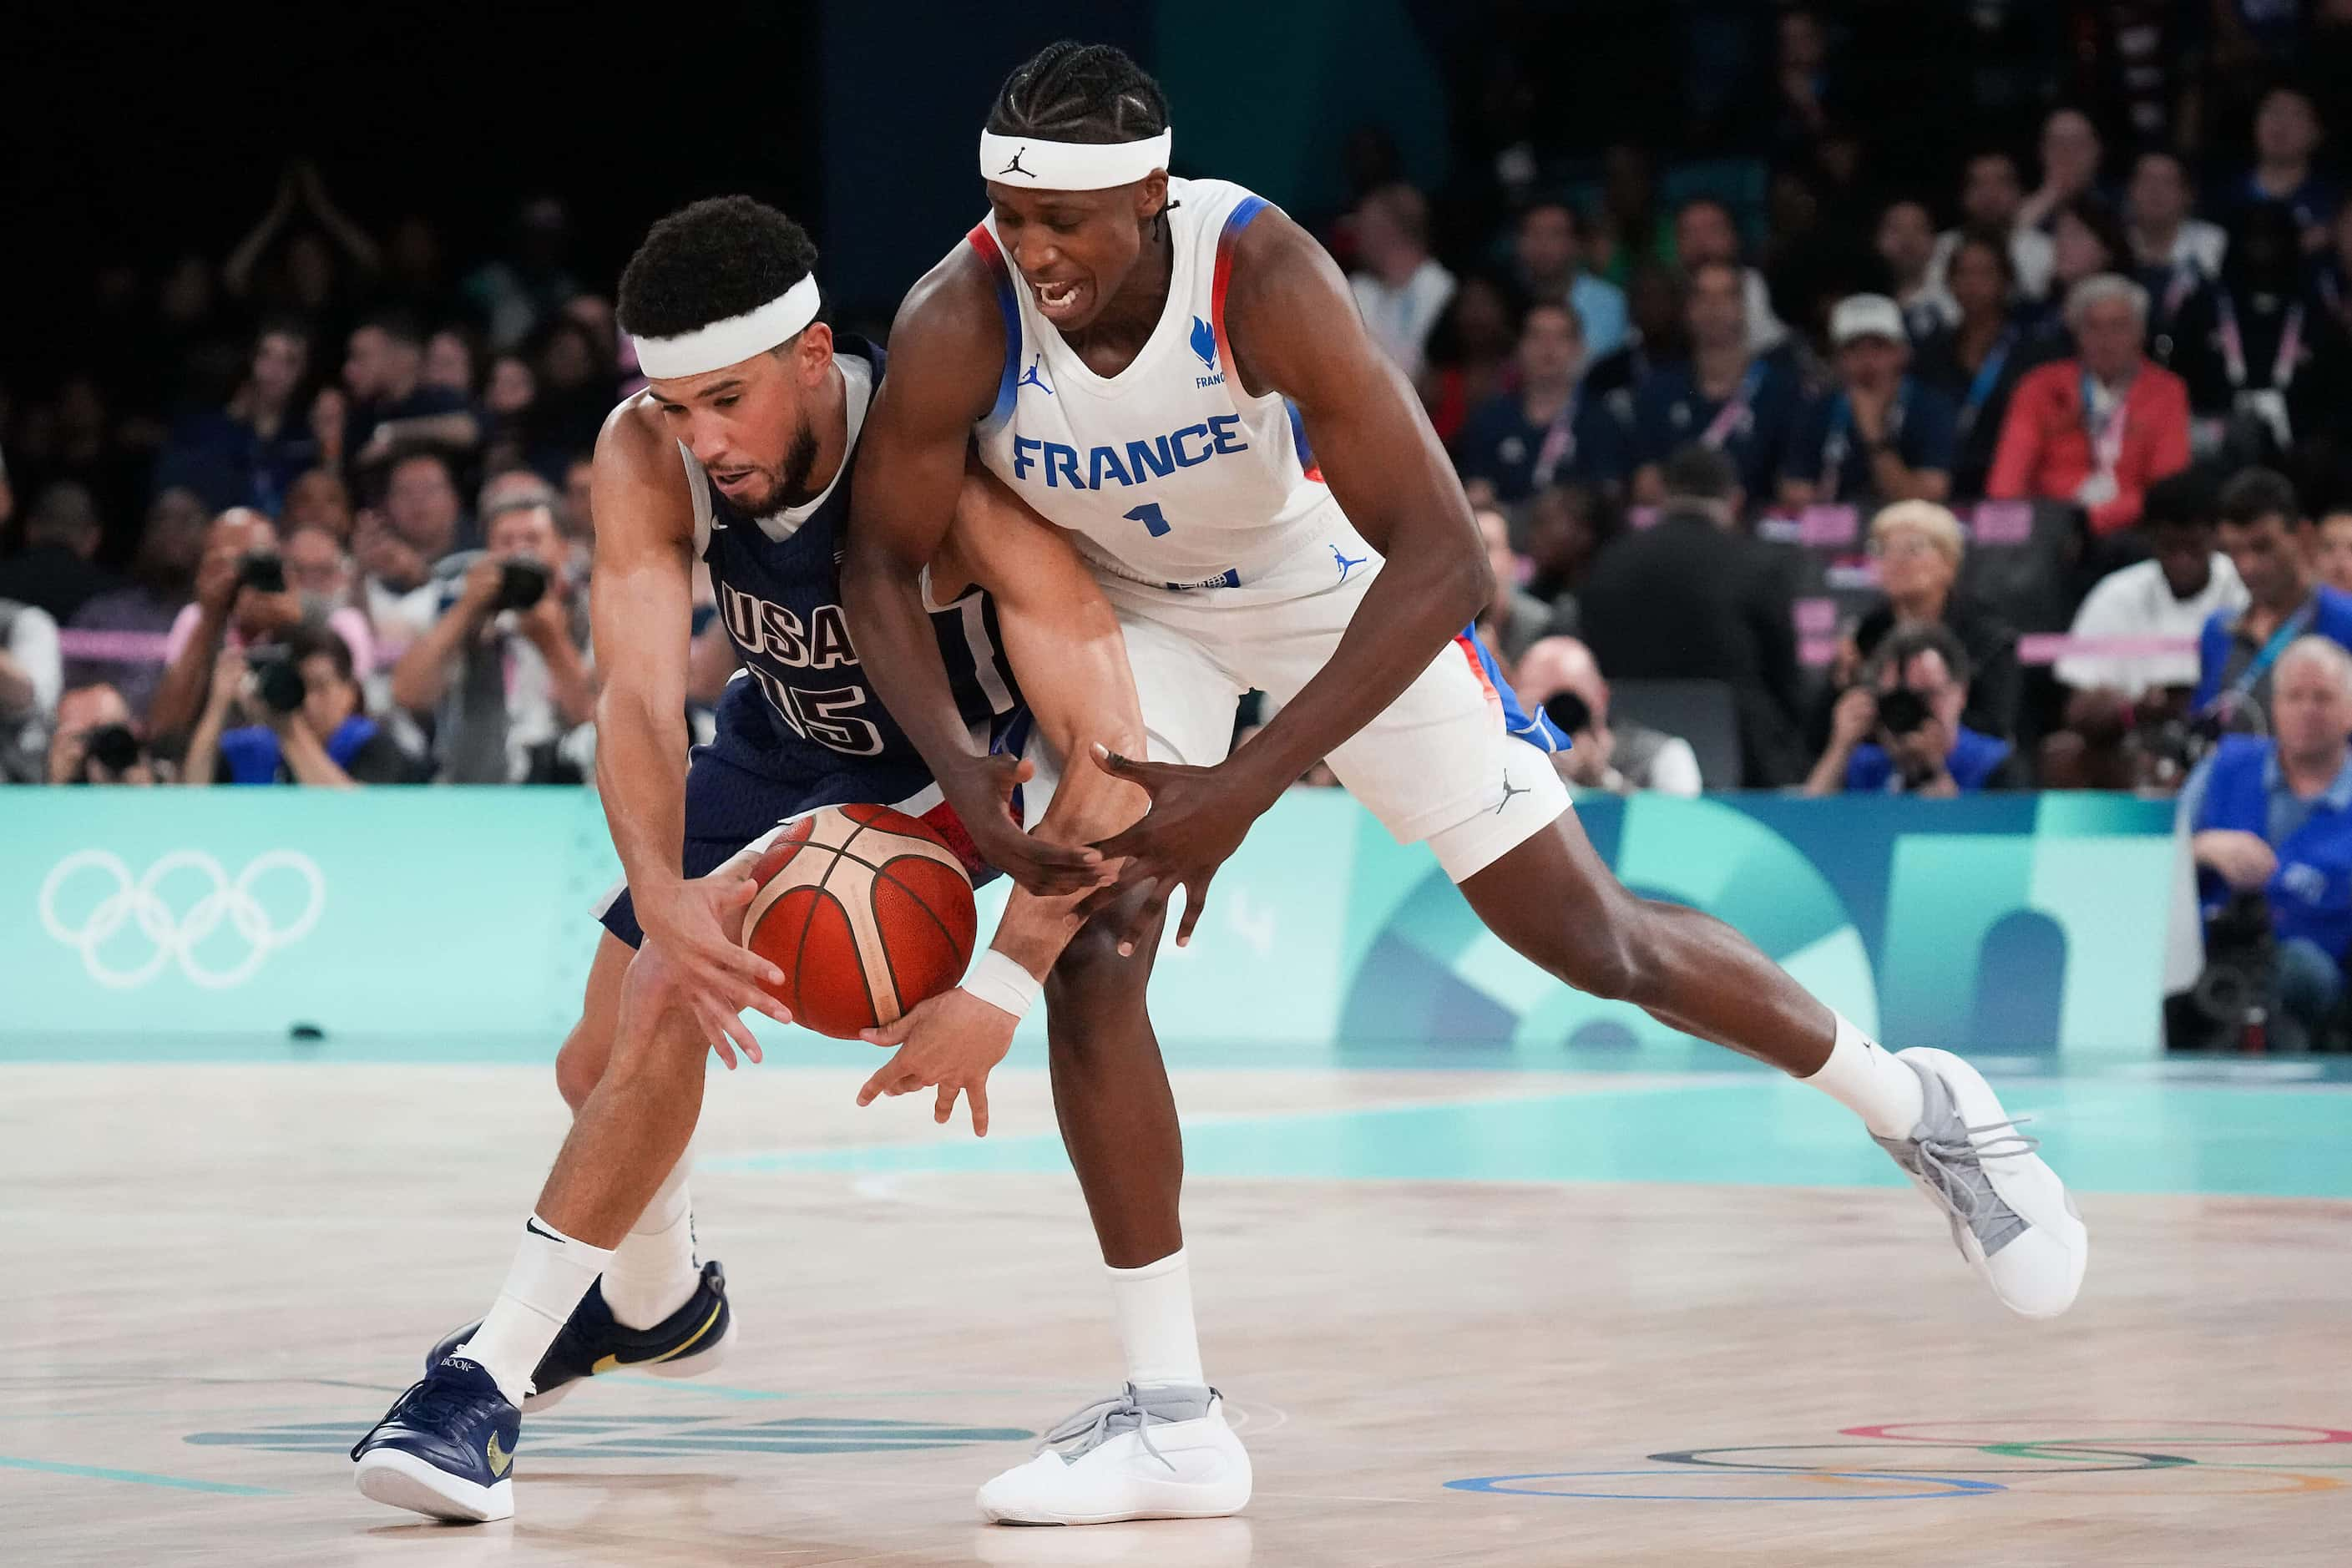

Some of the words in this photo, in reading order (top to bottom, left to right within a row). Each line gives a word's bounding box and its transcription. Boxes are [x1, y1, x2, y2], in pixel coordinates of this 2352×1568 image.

[1014, 413, 1248, 490] FRANCE
[1122, 502, 1171, 537] 1
[721, 579, 860, 670] USA
[746, 660, 885, 756] 15
[440, 1358, 476, 1372] BOOK
